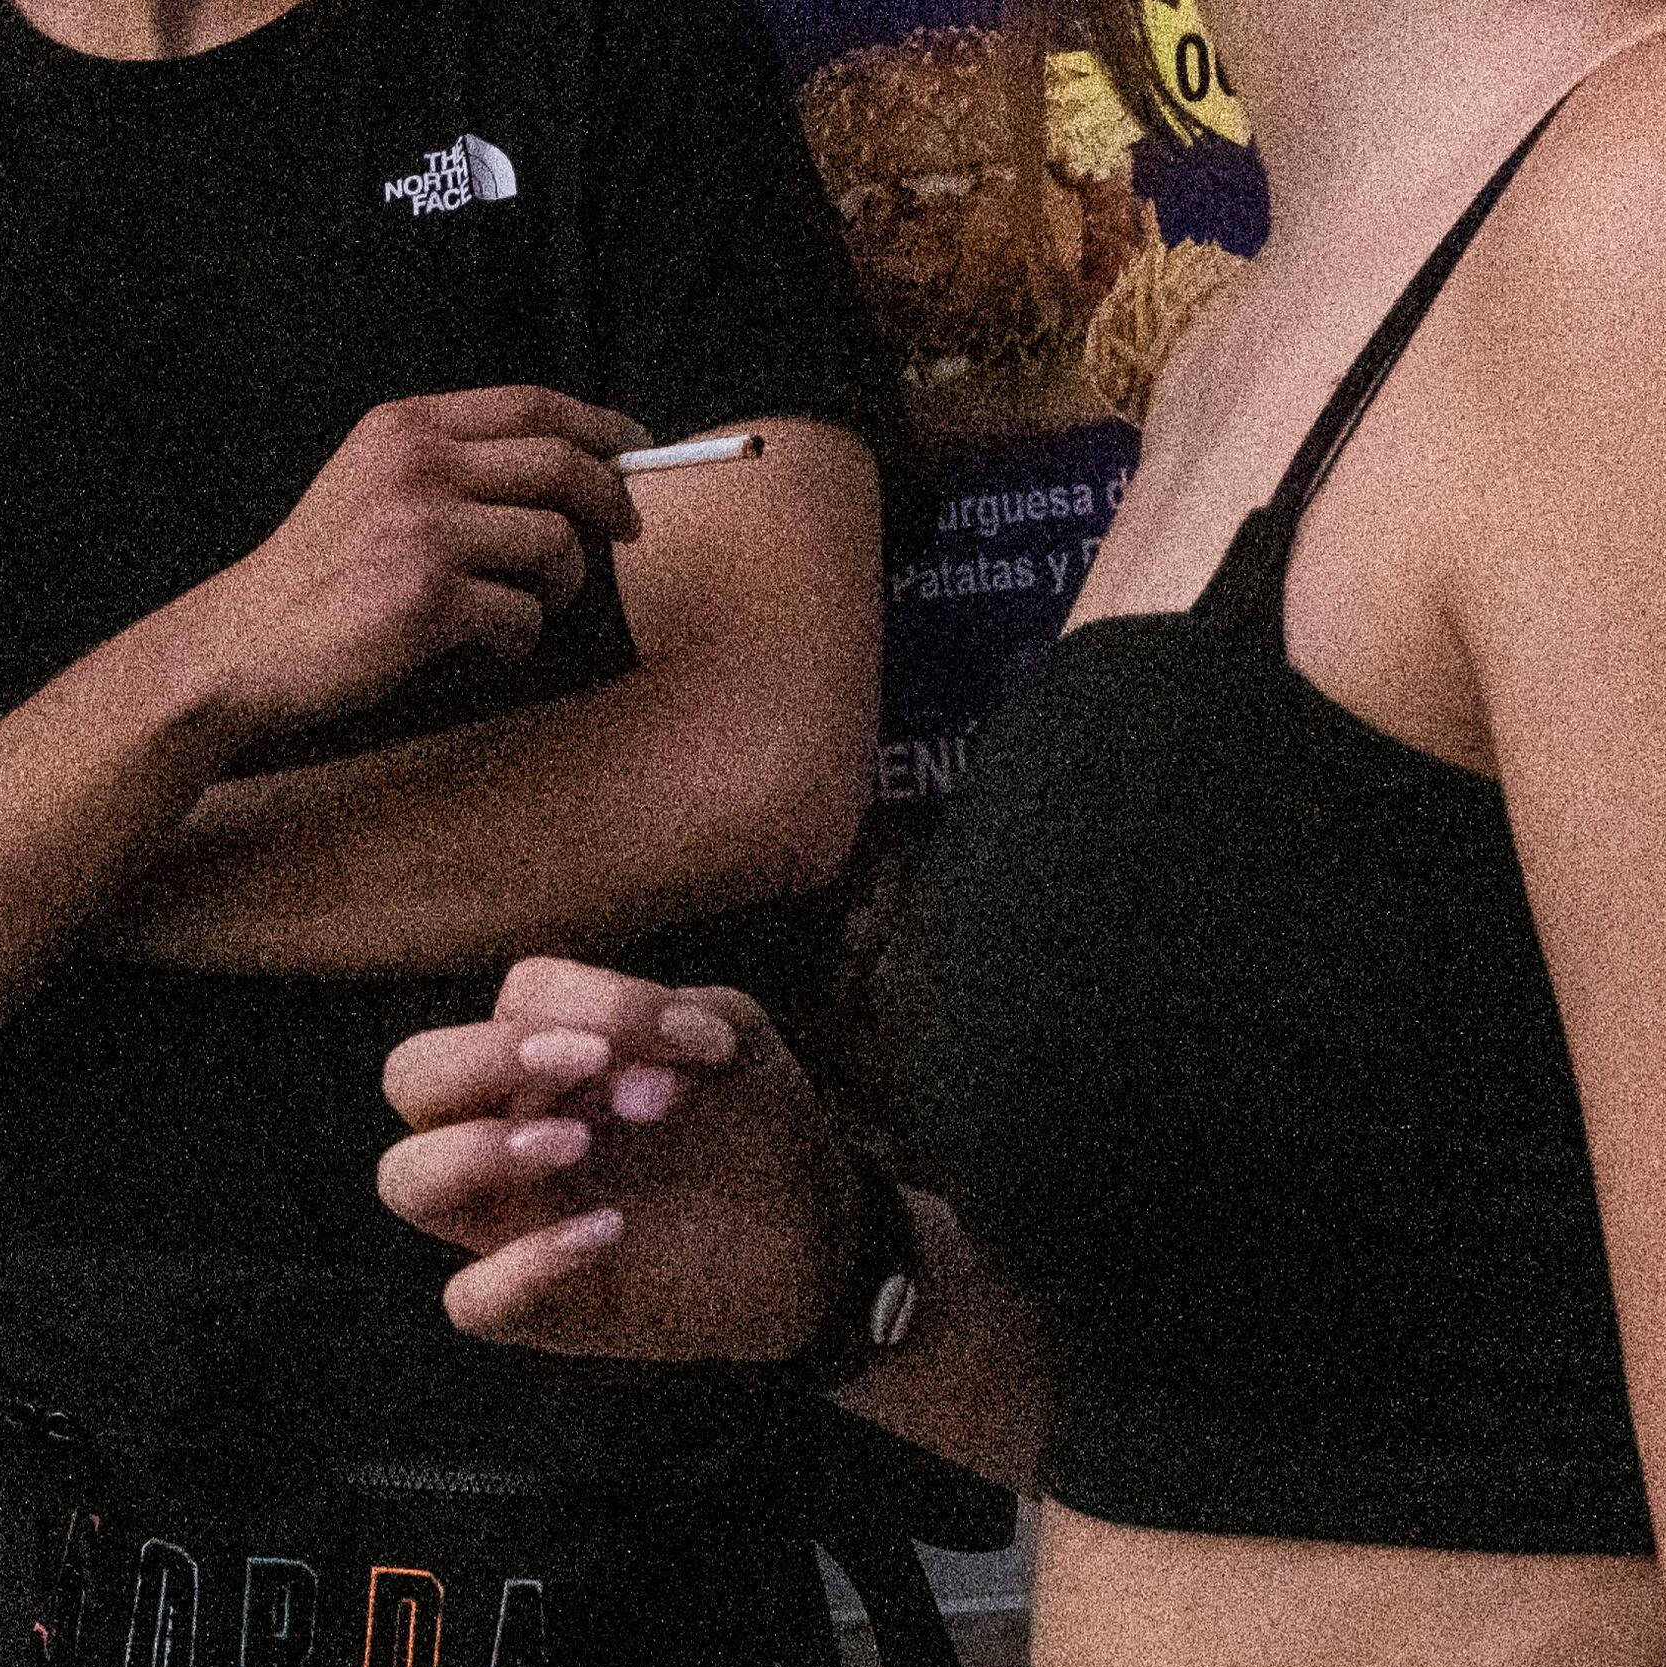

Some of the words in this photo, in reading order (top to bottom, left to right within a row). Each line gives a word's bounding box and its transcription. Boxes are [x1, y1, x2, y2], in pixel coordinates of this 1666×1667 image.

[423, 136, 465, 172] THE
[384, 165, 469, 203] NORTH
[412, 185, 472, 216] FACE
[1045, 550, 1071, 597] y
